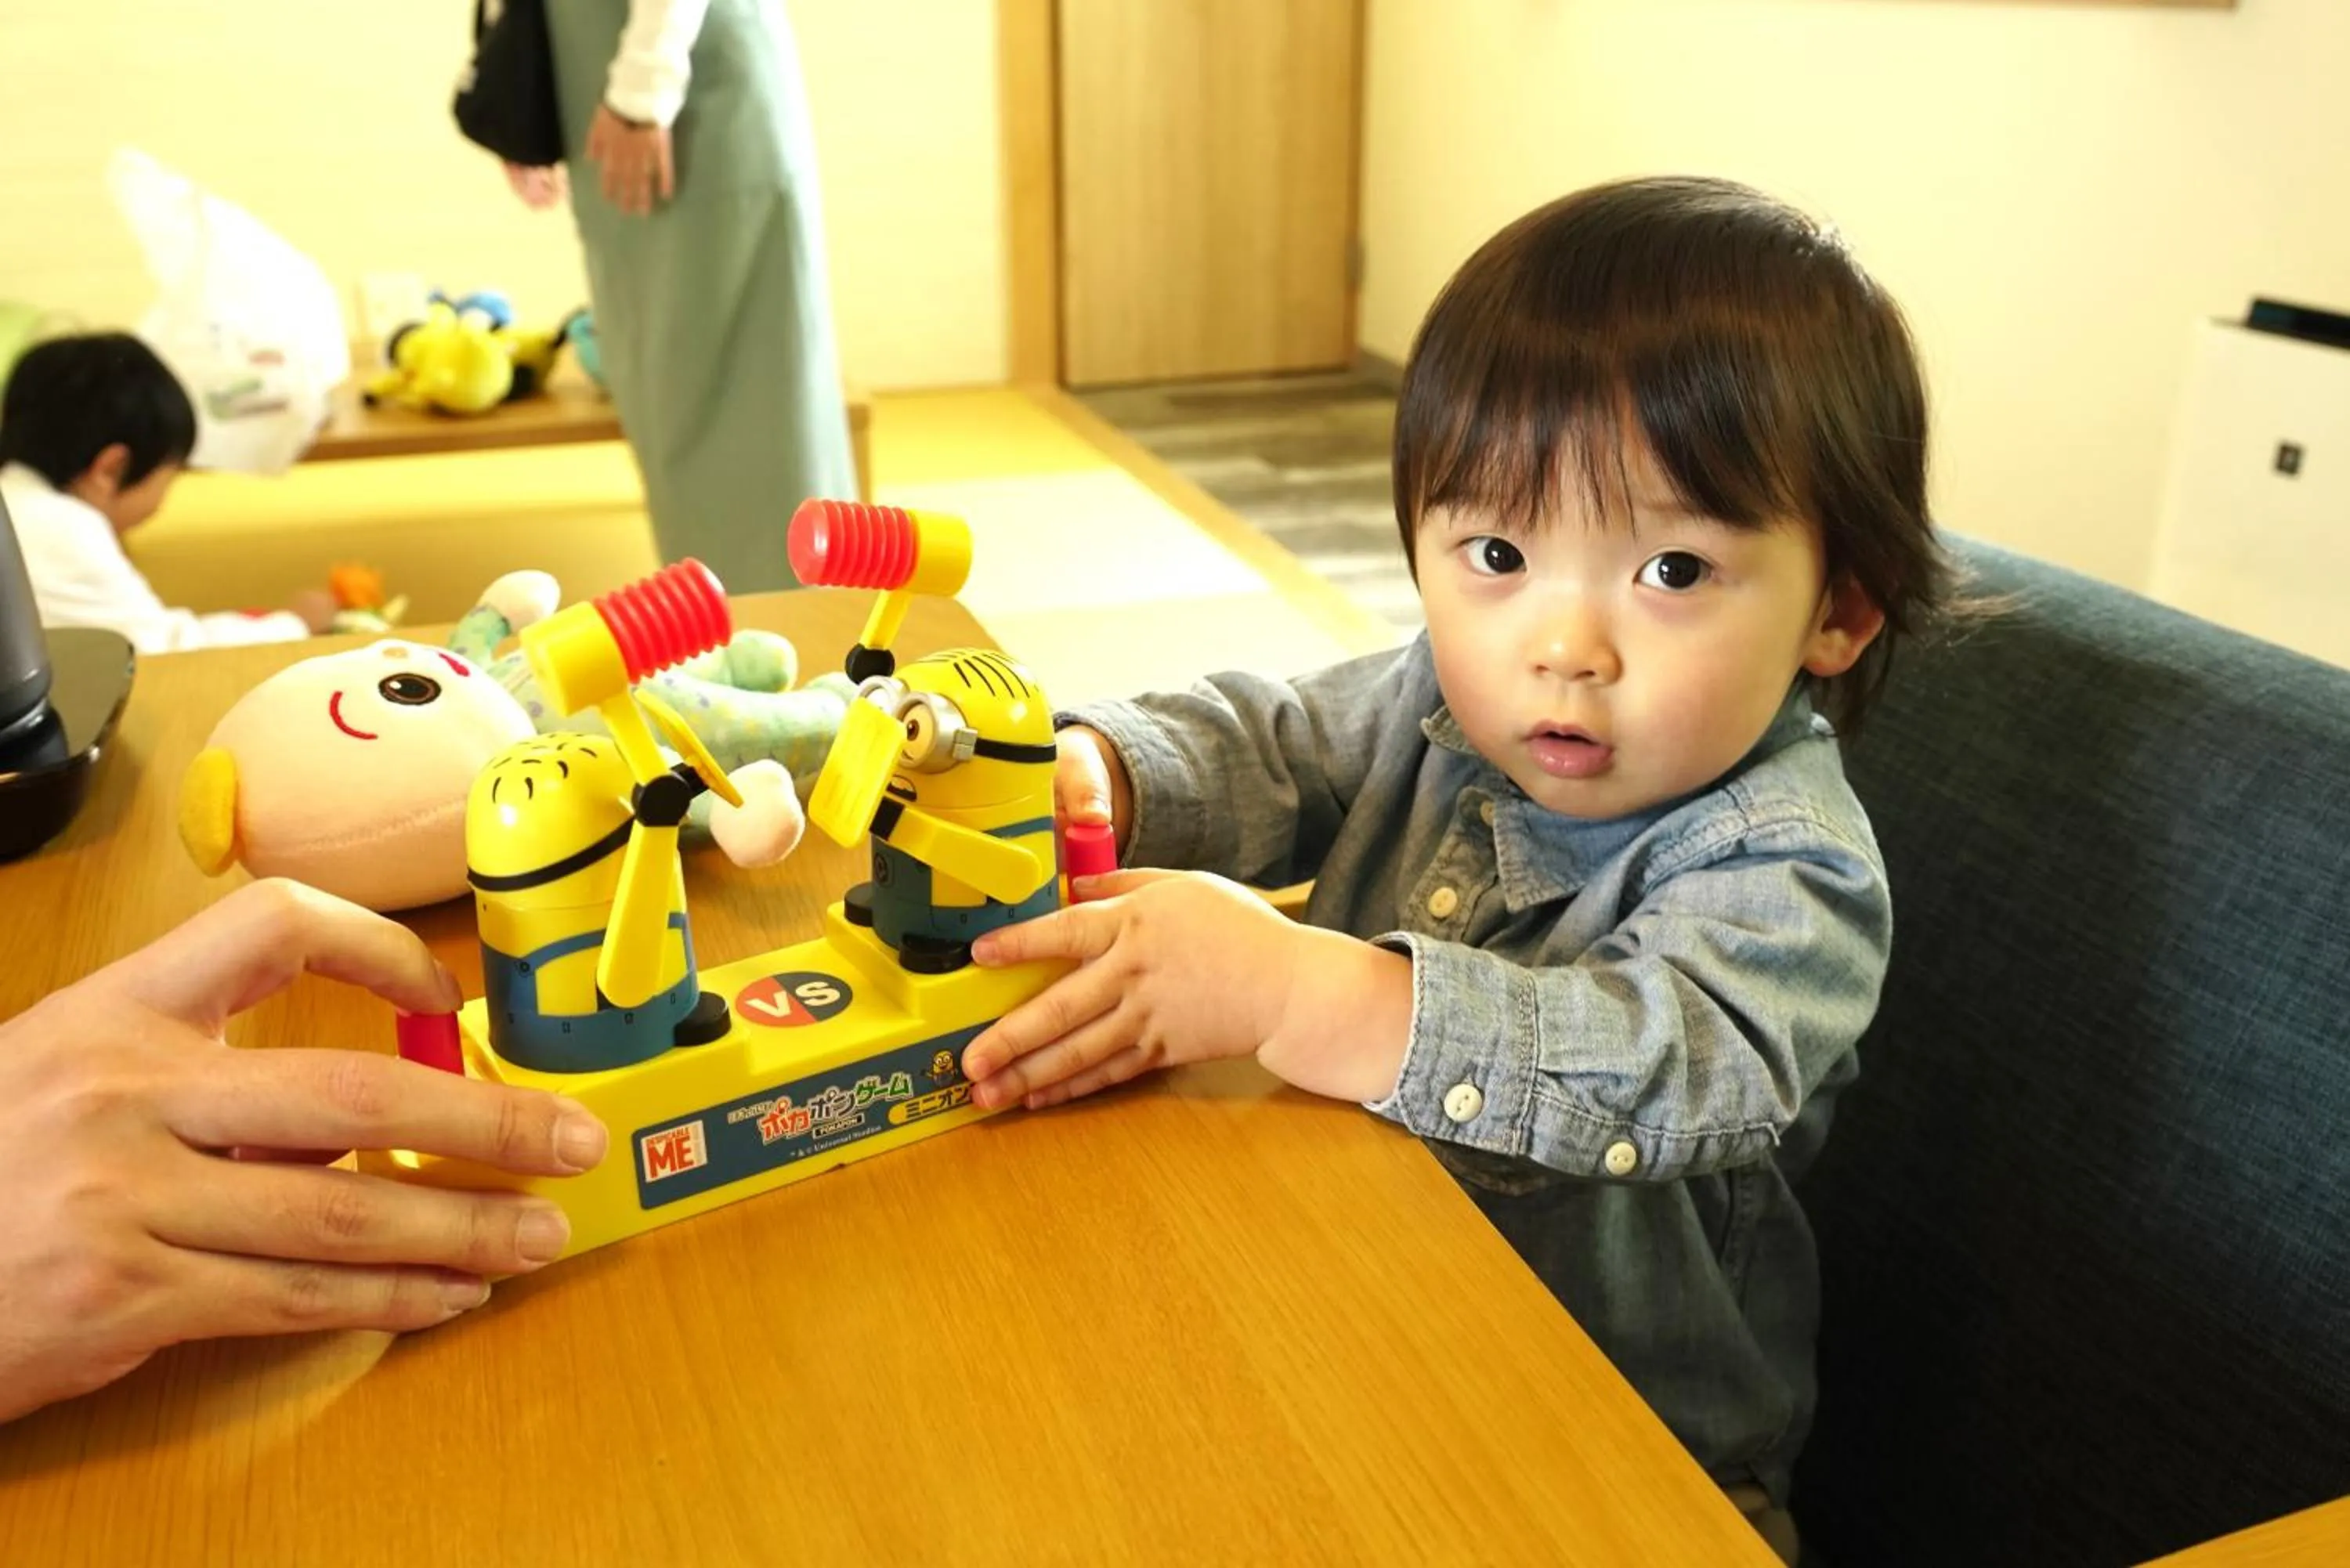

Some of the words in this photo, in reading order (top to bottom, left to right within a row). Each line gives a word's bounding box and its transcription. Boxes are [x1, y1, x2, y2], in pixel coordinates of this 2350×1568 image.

[745, 981, 841, 1017] VS
[758, 1072, 912, 1143] ポカポンゲーム
[648, 1135, 695, 1179] ME
